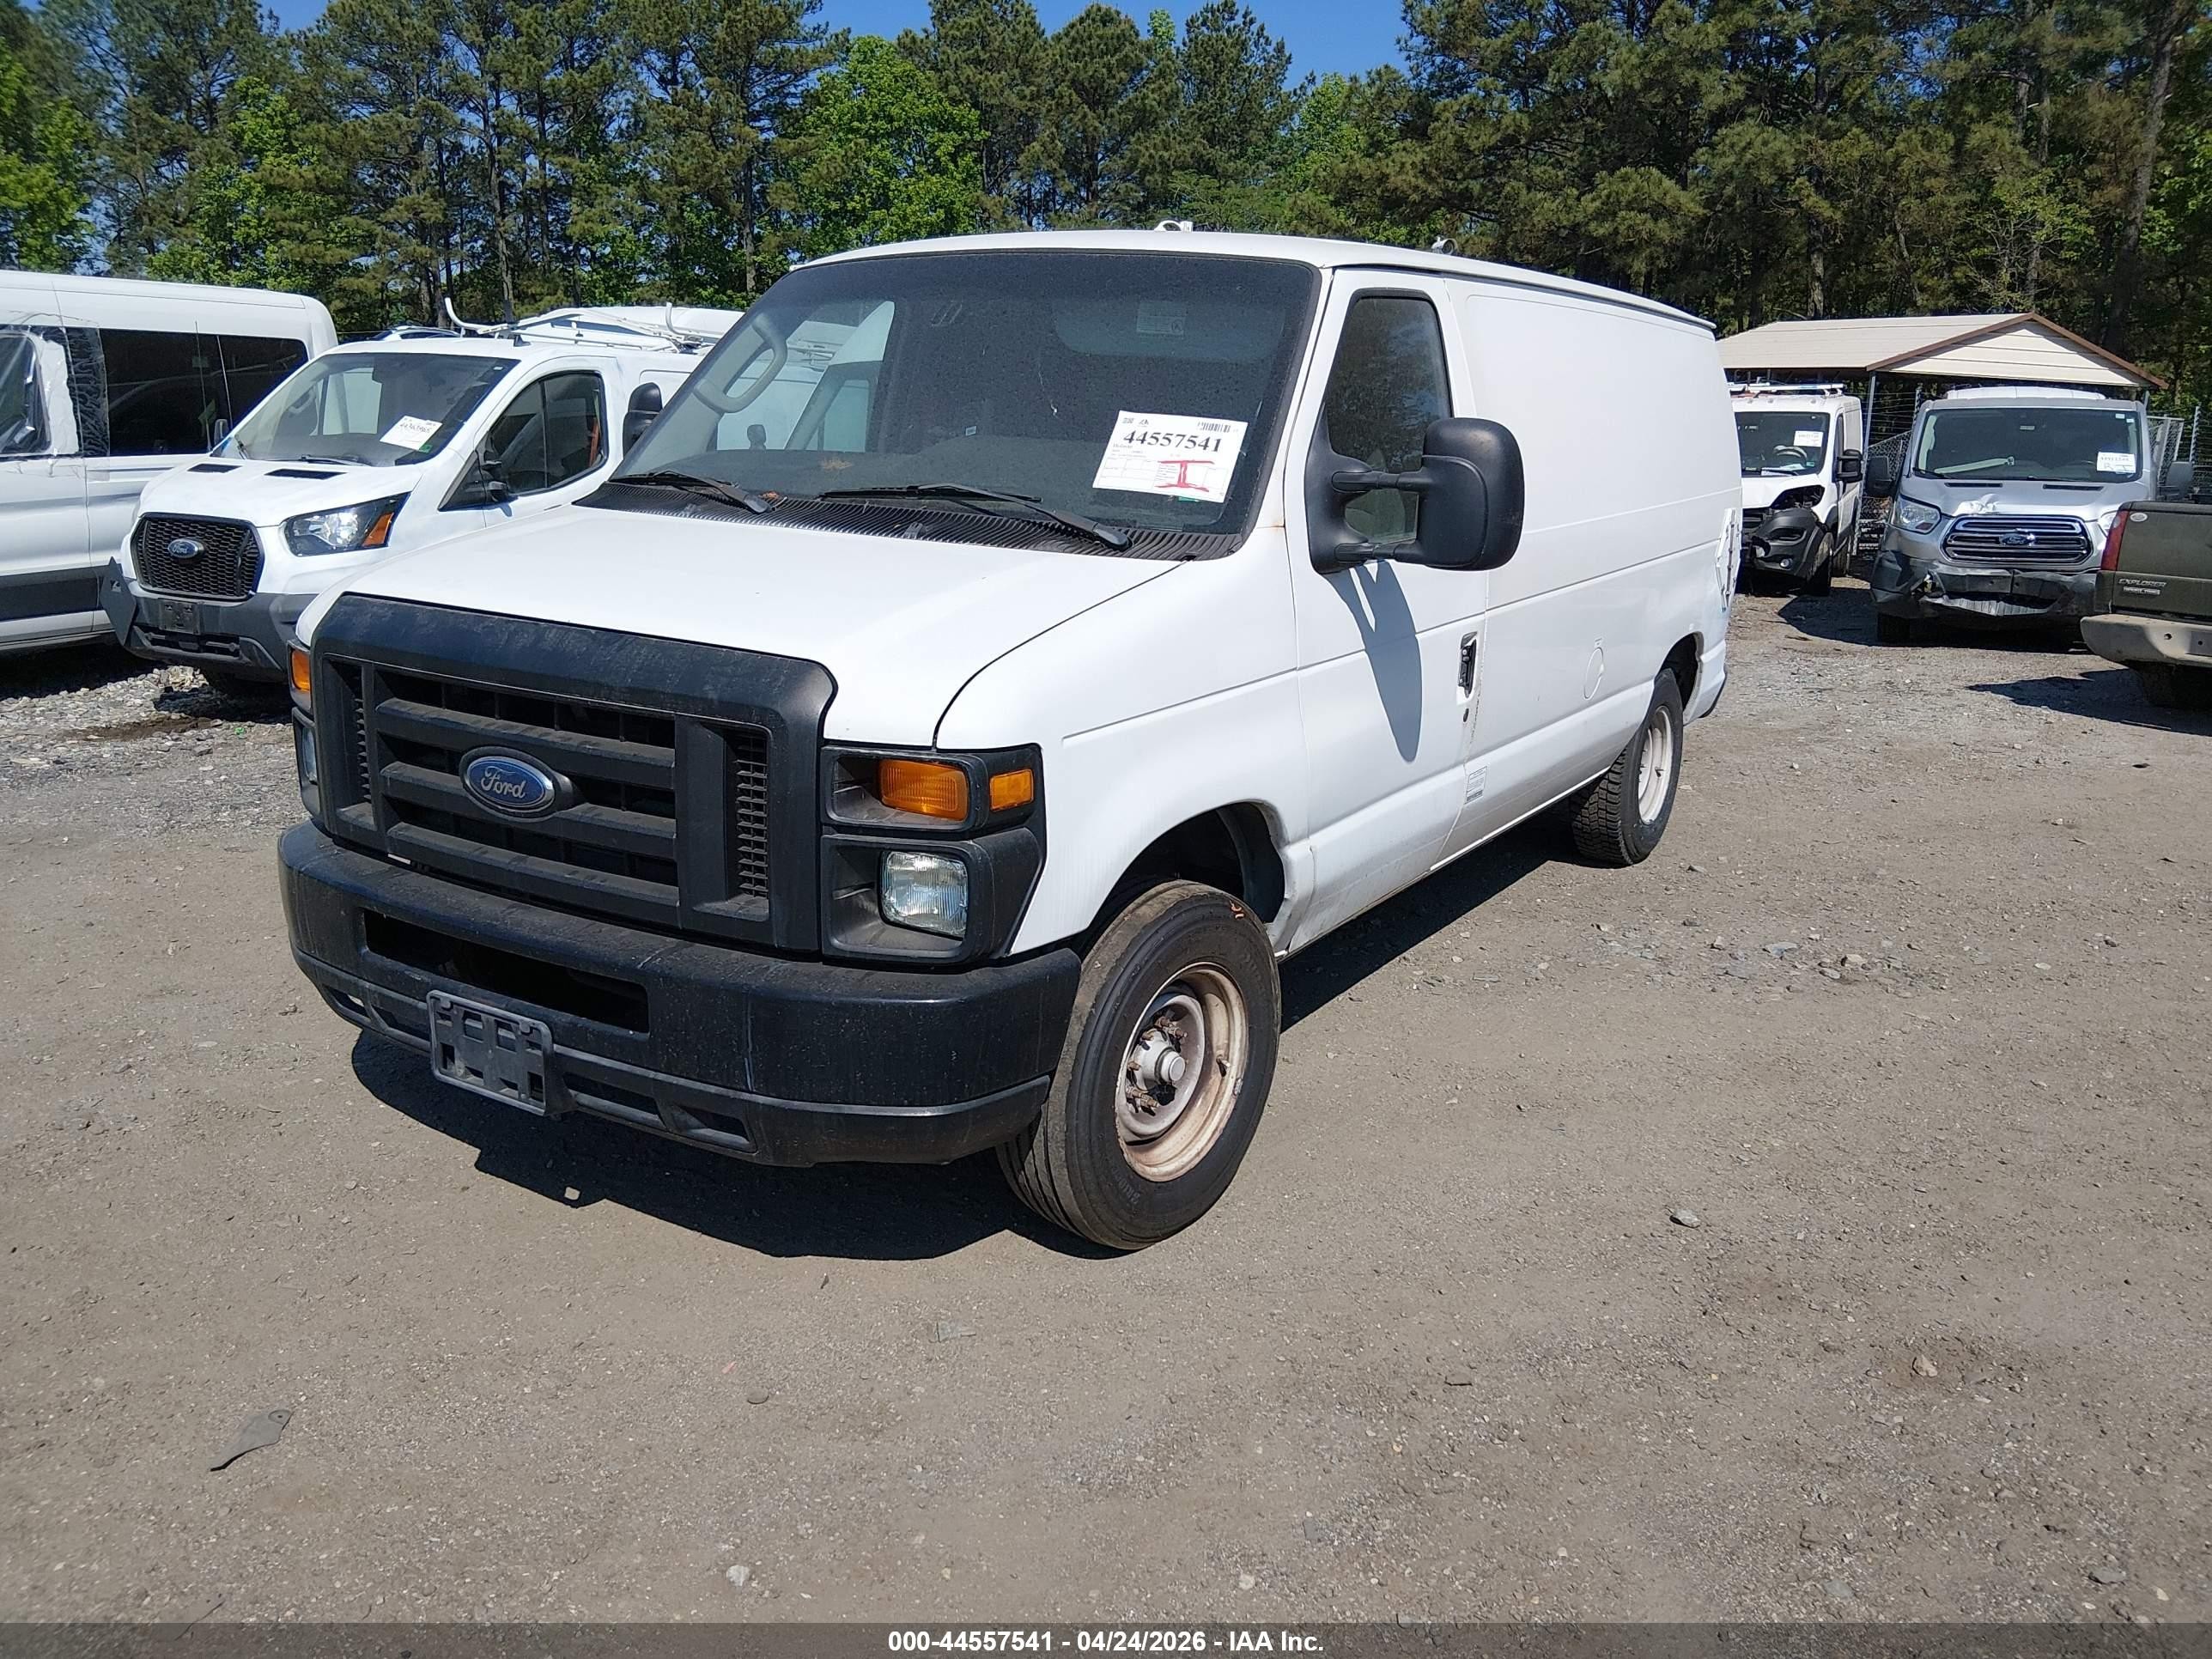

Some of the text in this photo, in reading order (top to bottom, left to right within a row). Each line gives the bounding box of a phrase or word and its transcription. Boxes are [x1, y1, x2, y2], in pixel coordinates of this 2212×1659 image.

[1123, 429, 1222, 453] 44557541
[2118, 578, 2167, 587] EXPLORER
[480, 765, 526, 799] Ford
